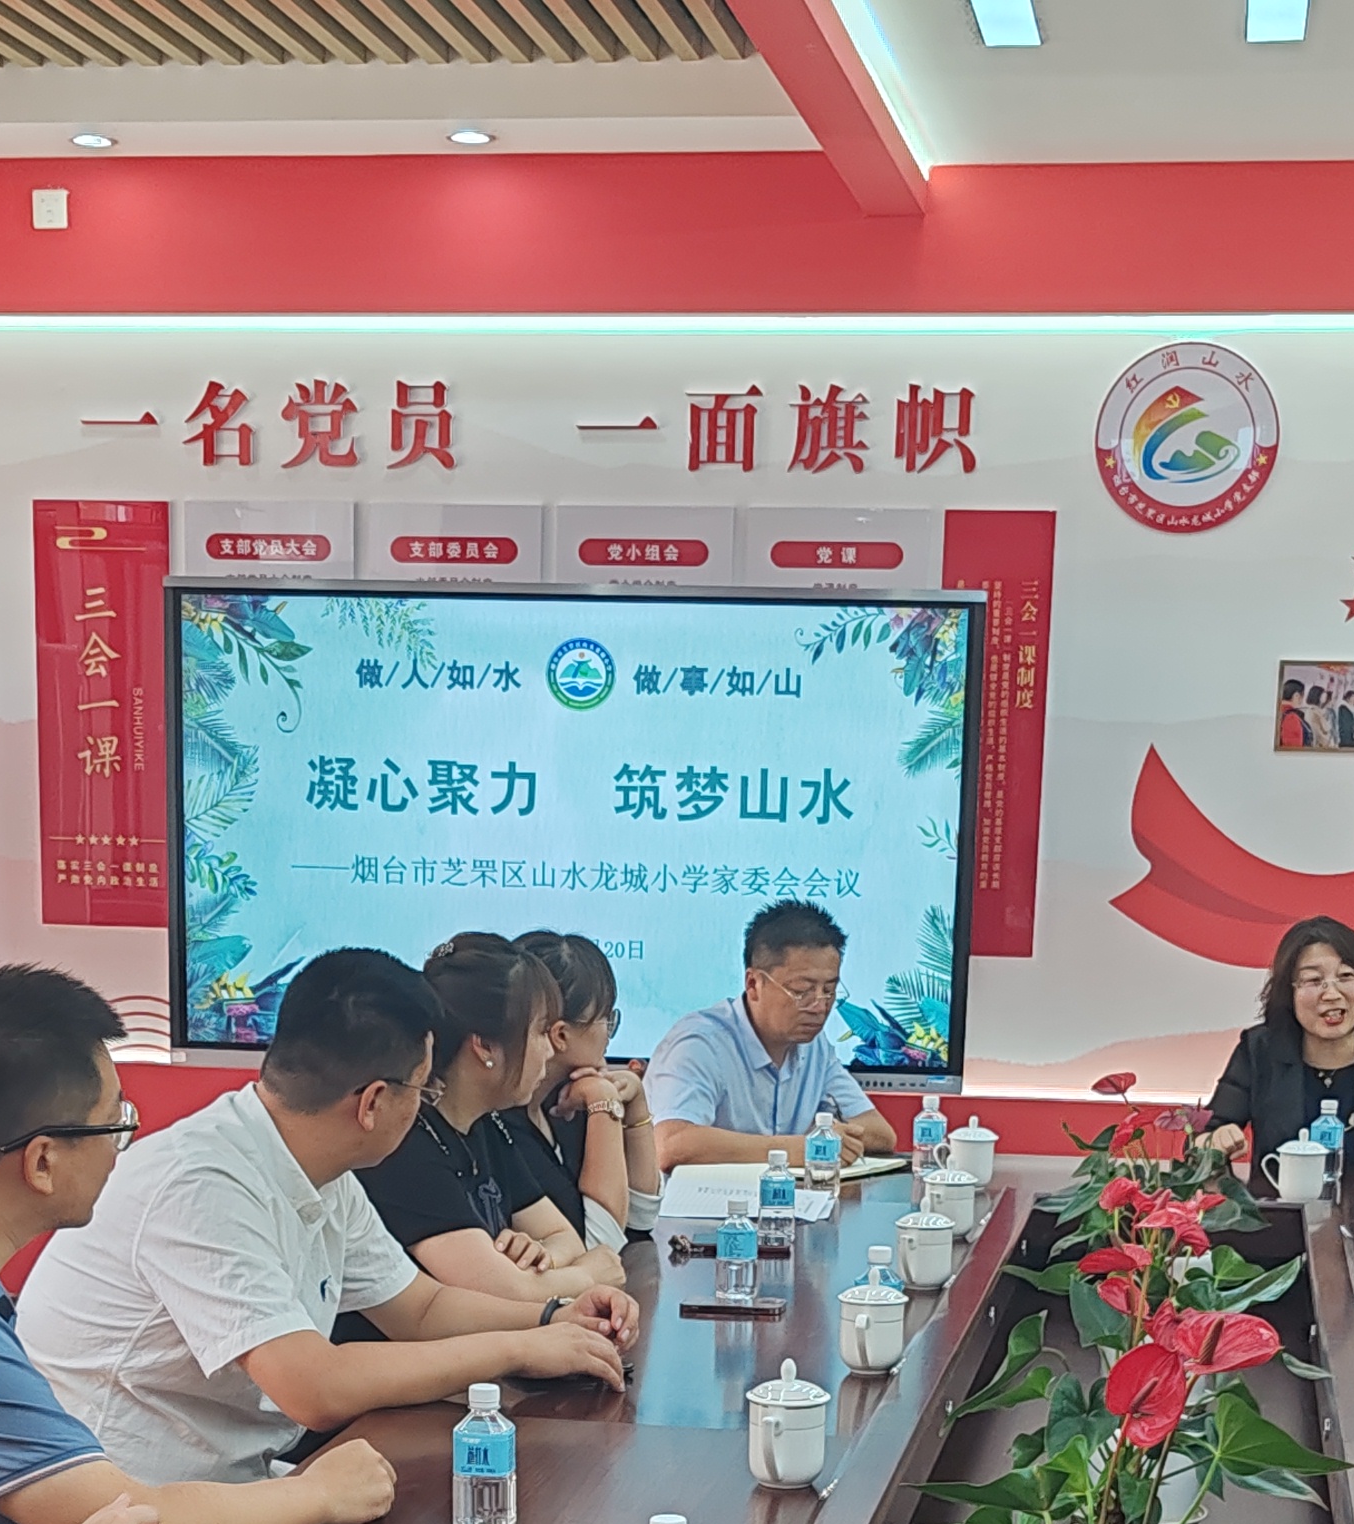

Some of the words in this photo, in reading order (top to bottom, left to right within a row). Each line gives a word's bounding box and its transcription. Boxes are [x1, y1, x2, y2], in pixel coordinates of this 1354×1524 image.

[80, 379, 457, 471] 一名党员
[575, 383, 979, 475] 一面旗帜
[219, 538, 318, 558] 支部党员大会
[408, 541, 499, 560] 支部委员会
[606, 543, 680, 562] 党小组会
[815, 547, 858, 564] 党课
[1014, 579, 1039, 710] 三会一课制度
[74, 585, 123, 779] 三会一课
[355, 658, 522, 692] 做/人/如/水
[633, 664, 803, 699] 做/事/如/山
[132, 687, 145, 772] SANHUIYIKE
[304, 756, 538, 819] 凝心聚力
[612, 762, 854, 826] 筑梦山水
